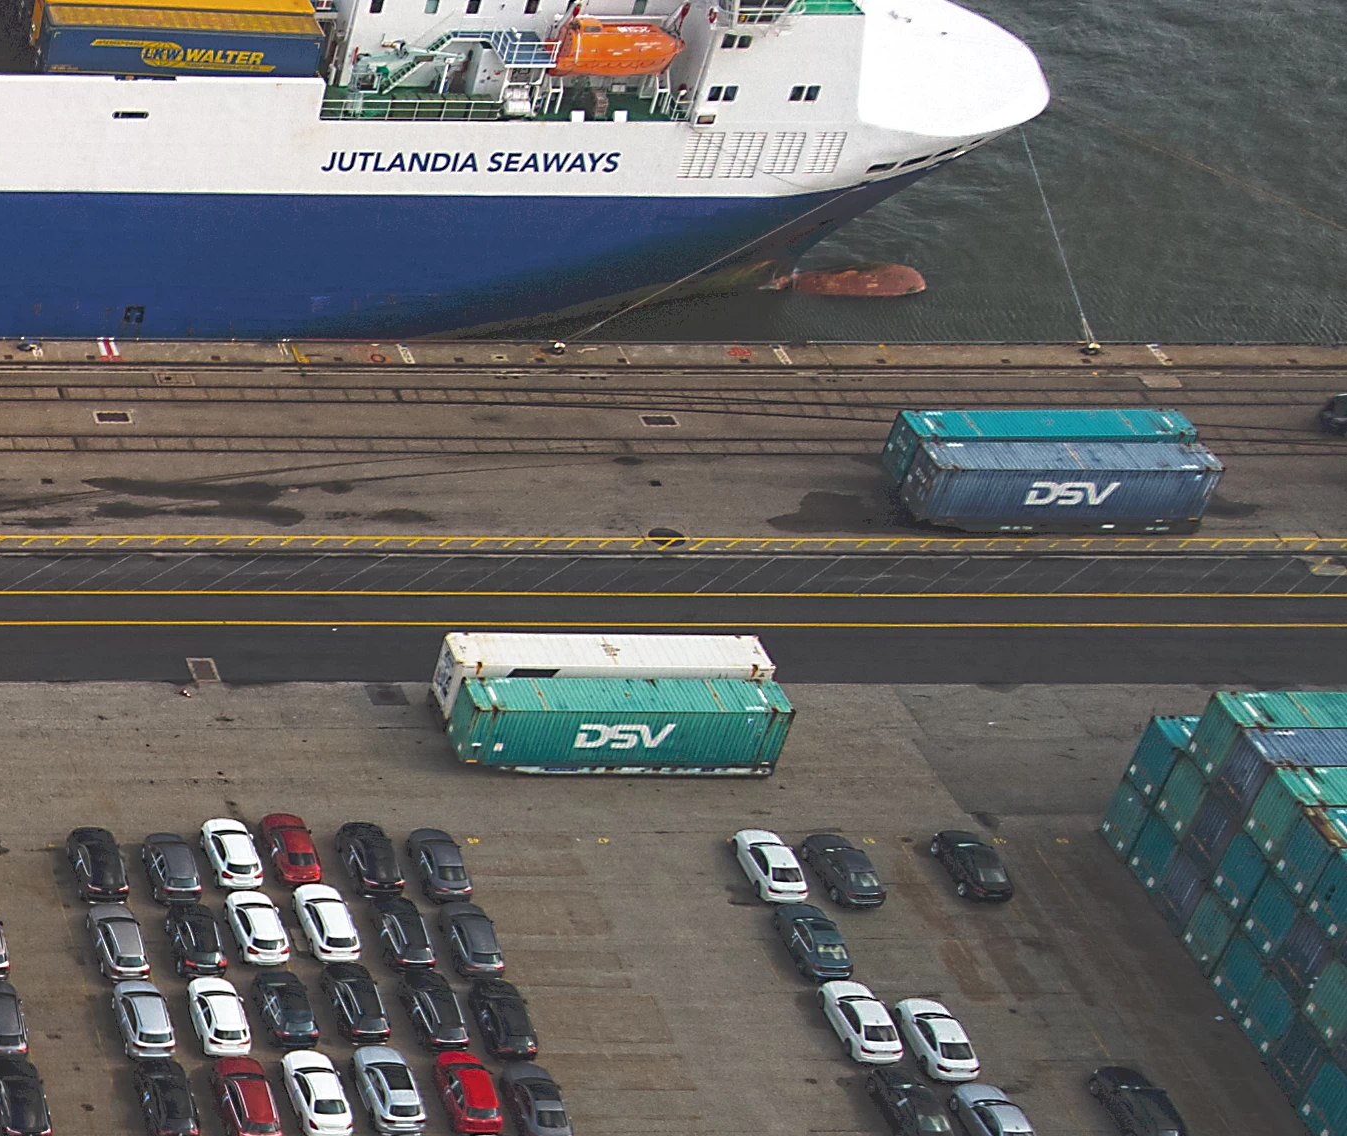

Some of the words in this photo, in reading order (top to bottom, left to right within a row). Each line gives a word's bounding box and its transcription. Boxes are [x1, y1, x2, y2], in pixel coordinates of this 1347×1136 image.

[144, 48, 180, 60] LKW
[186, 48, 264, 65] WALTER
[321, 150, 478, 174] JUTLANDIA
[486, 151, 621, 174] SEAWAYS
[1023, 481, 1121, 506] DSV
[574, 723, 676, 750] DSV
